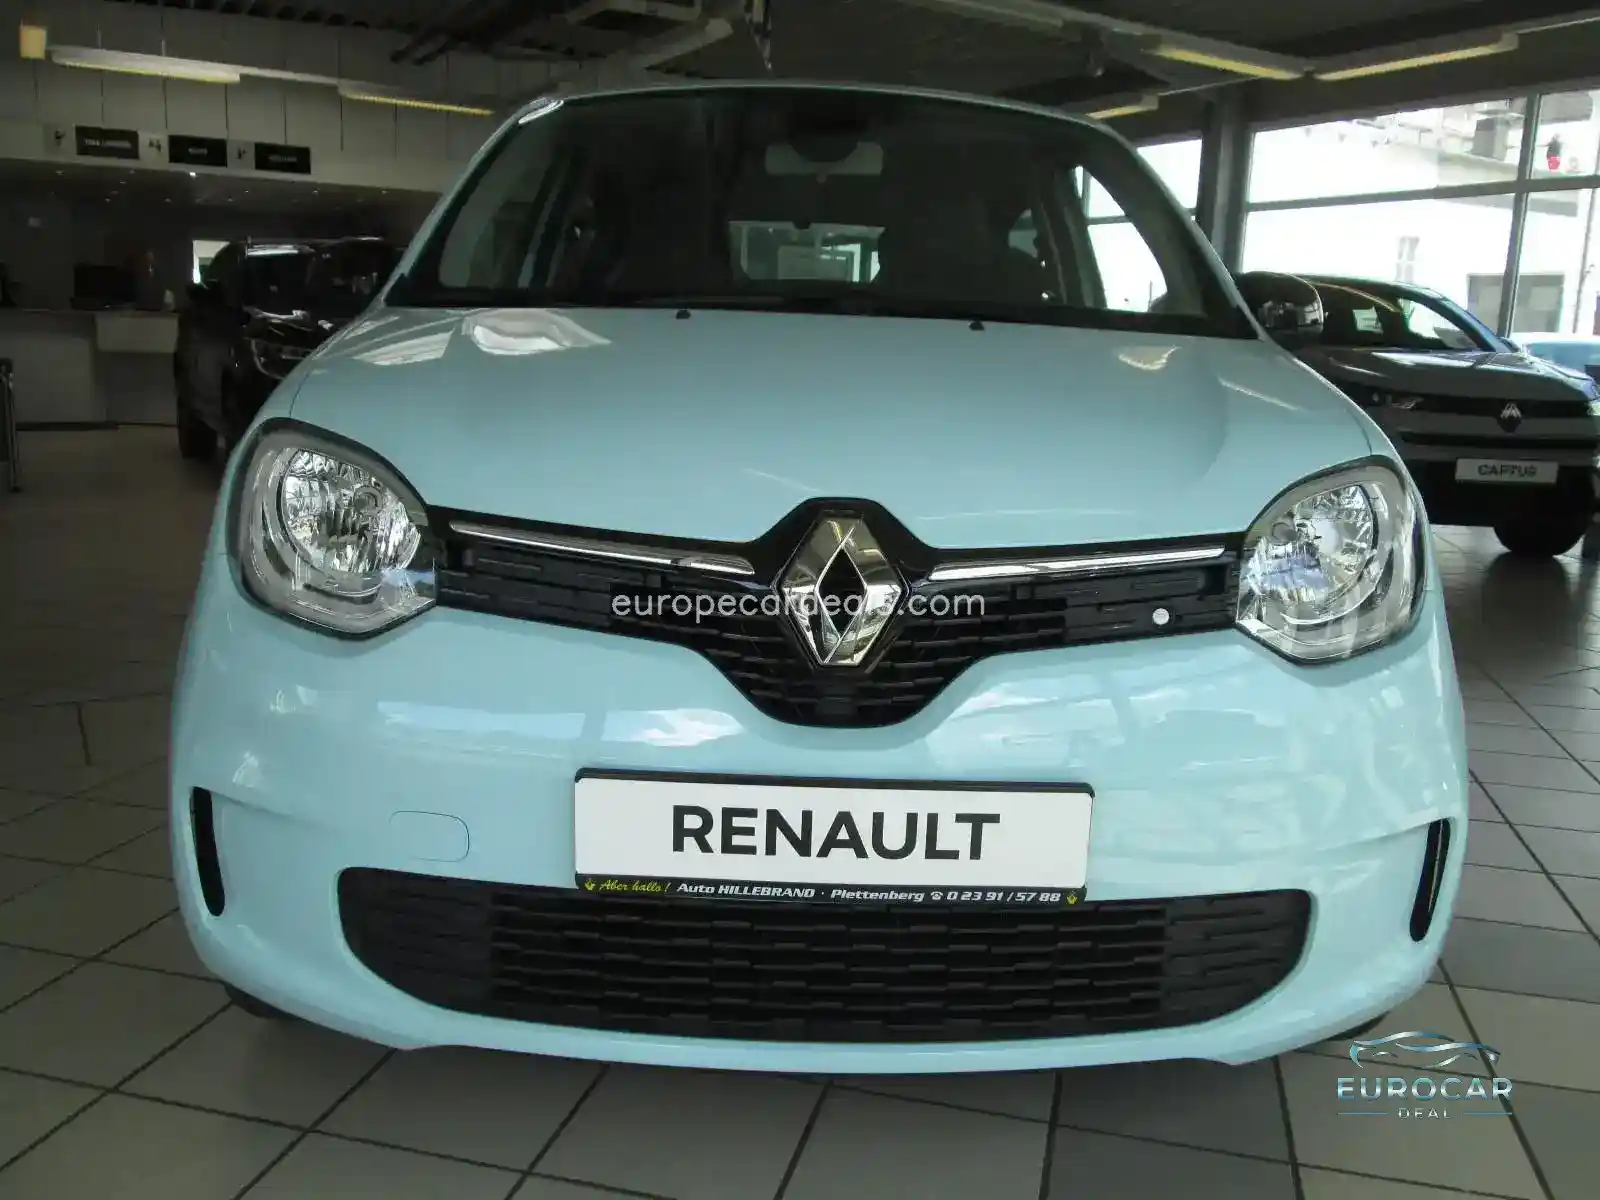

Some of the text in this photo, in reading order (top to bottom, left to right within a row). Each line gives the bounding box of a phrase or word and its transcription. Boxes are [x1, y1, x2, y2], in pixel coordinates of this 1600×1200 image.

[672, 804, 1001, 861] RENAULT
[599, 879, 628, 892] Aber
[676, 882, 715, 894] Auto
[717, 885, 816, 898] HILLEBRAND
[830, 888, 925, 903] Plettenberg
